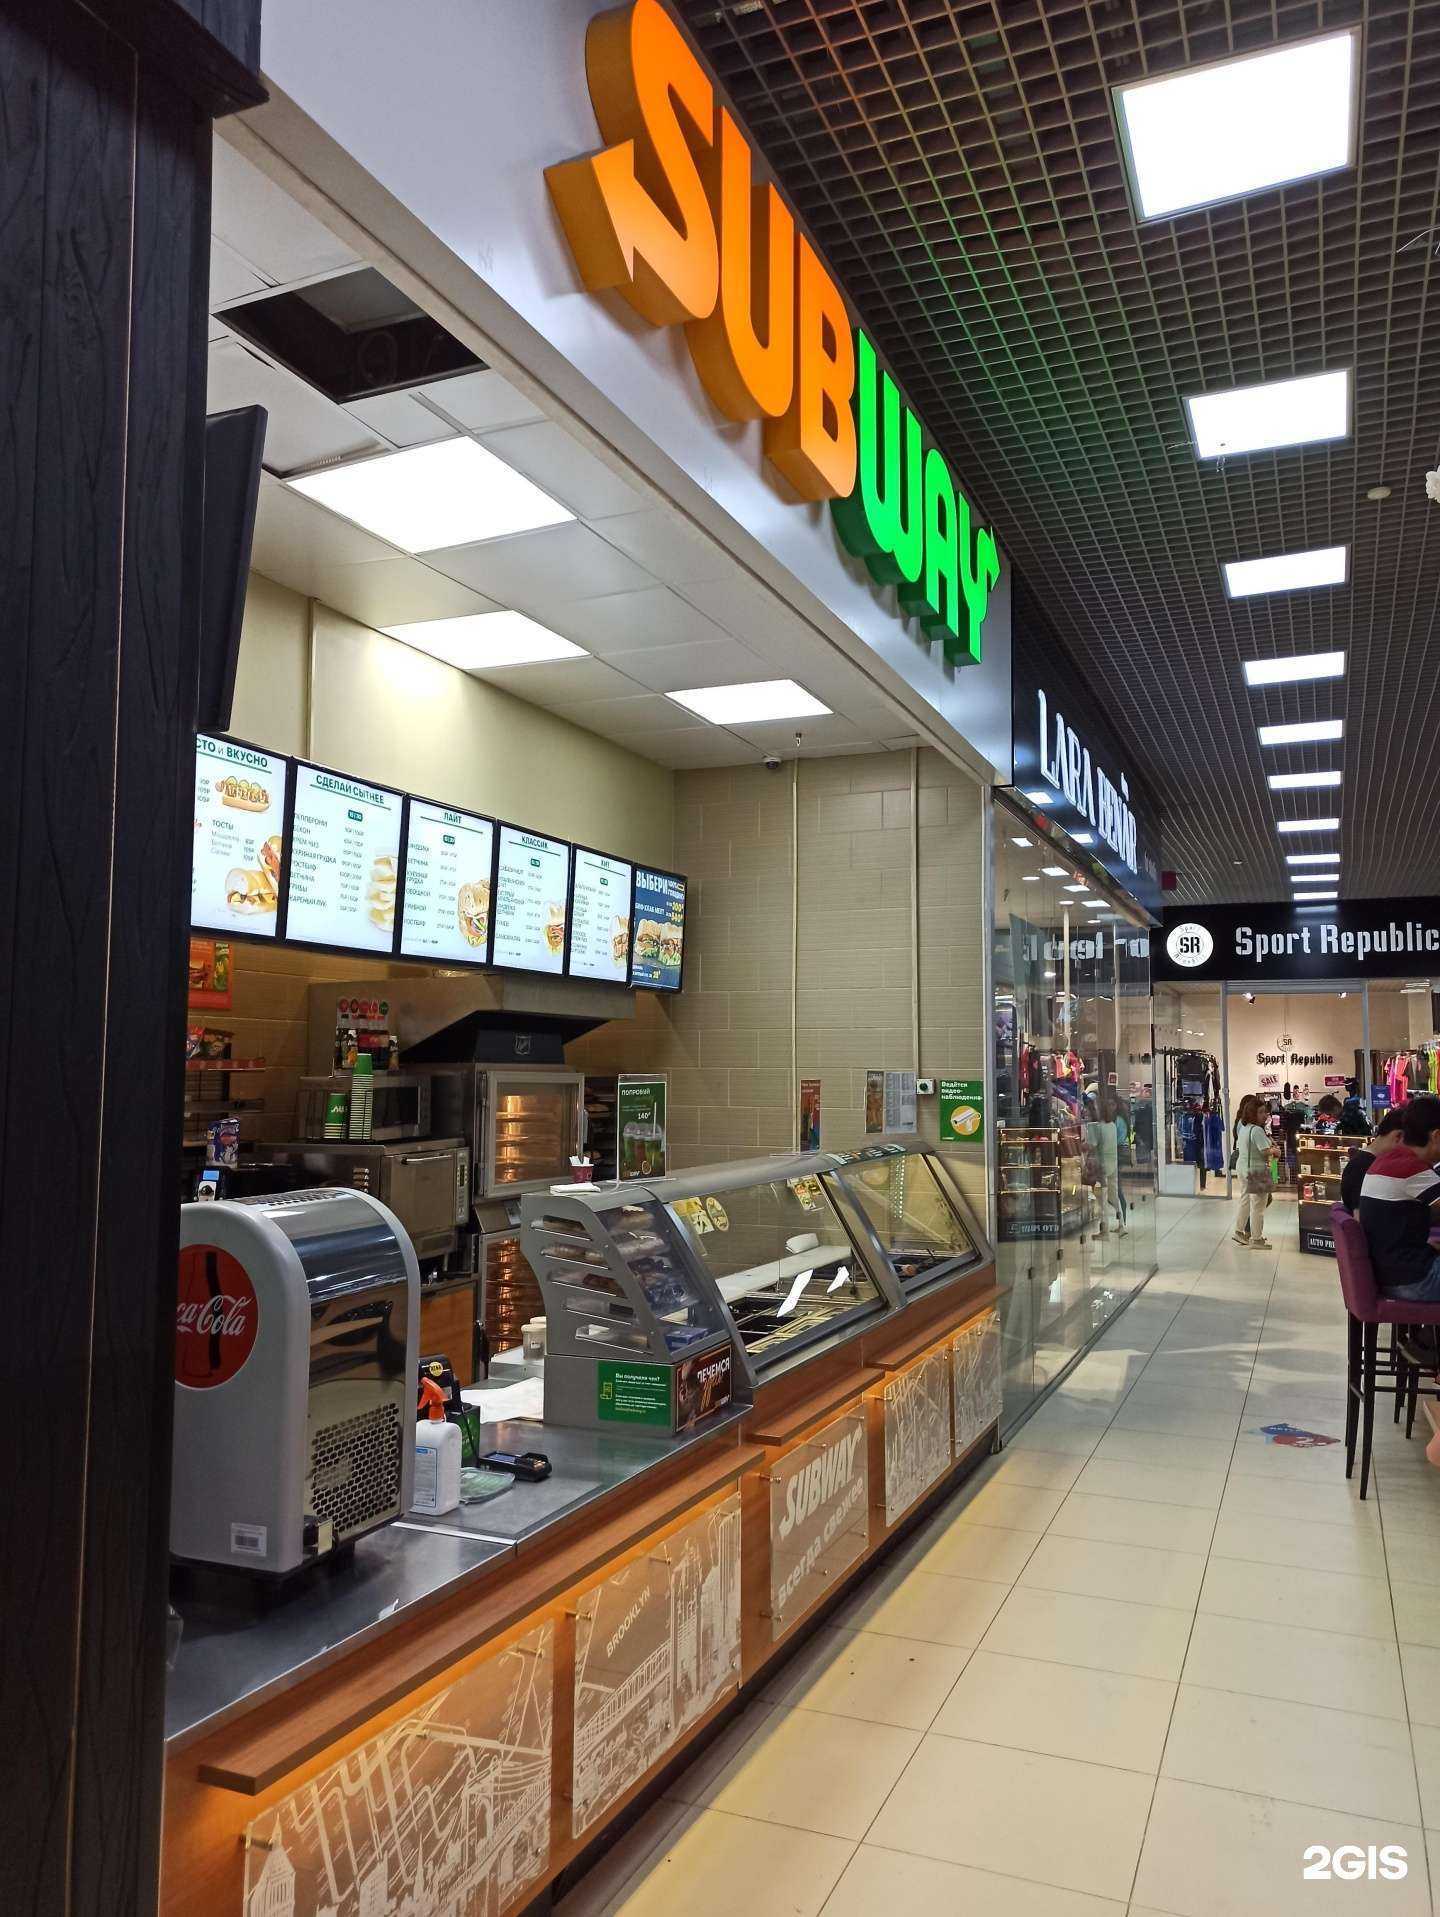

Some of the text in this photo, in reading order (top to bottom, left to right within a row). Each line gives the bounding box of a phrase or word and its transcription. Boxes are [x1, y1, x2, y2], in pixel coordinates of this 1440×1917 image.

[550, 0, 1000, 665] SUBWAY
[226, 747, 268, 768] ВКУСНО
[1037, 688, 1097, 827] LARA
[443, 812, 462, 825] ЛАЙТ
[521, 835, 549, 849] КЛАССИК
[636, 870, 668, 896] ВЫБЕРИ
[1180, 936, 1200, 954] SR
[1235, 922, 1440, 963] Sport Republic
[1257, 1052, 1334, 1068] Sport Republic
[778, 1422, 863, 1542] SUBWAY
[606, 1585, 651, 1659] BROOKLYN
